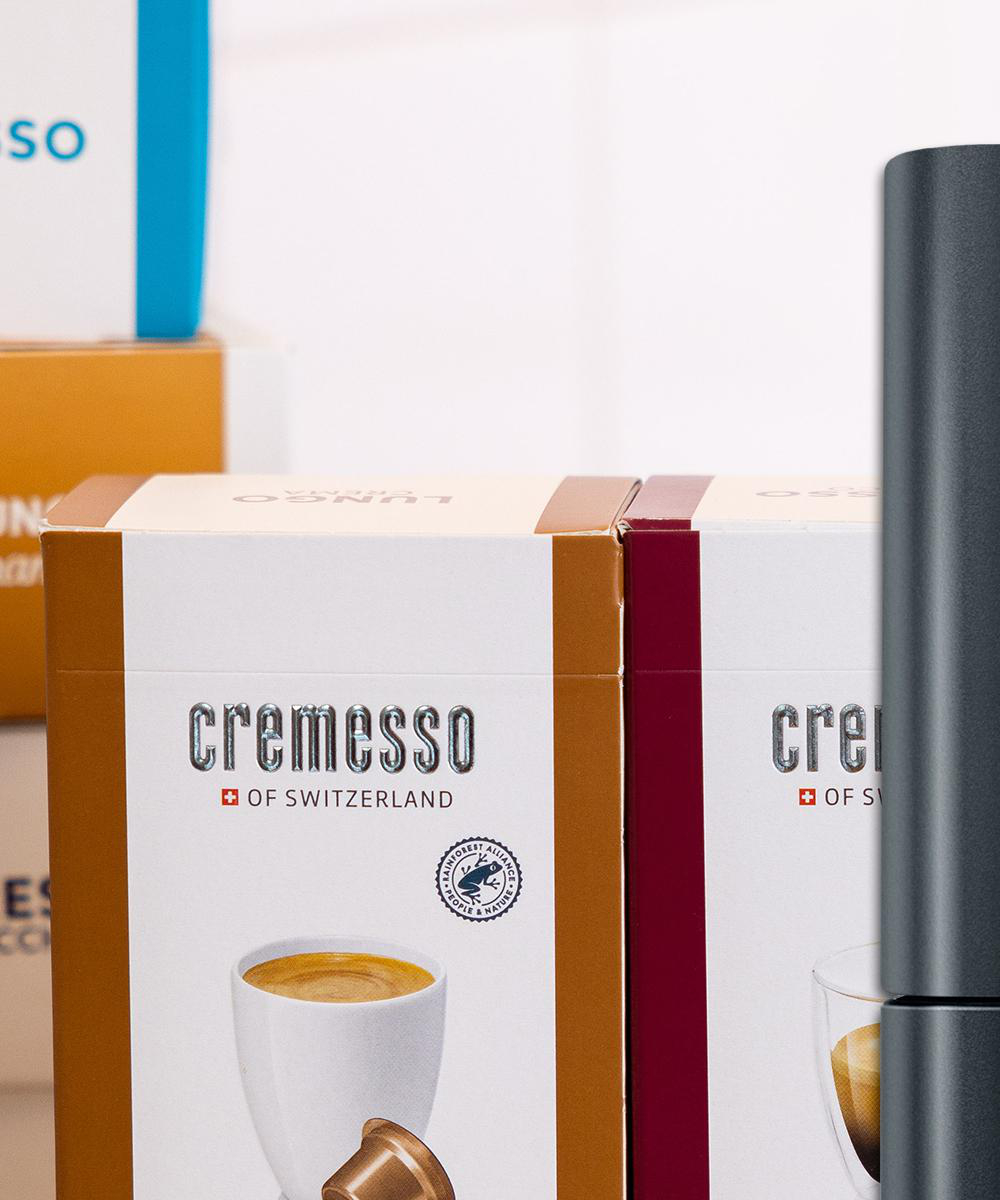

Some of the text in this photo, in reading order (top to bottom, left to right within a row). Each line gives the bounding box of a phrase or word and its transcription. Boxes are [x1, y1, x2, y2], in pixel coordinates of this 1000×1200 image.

[0, 120, 85, 160] SO
[232, 494, 453, 504] LUNGO
[189, 702, 476, 775] cremesso
[772, 703, 882, 774] cre
[248, 788, 454, 809] OF SWITZERLAND
[825, 787, 882, 806] OF S
[443, 843, 516, 882] RAINFOREST ALLIANCE
[445, 889, 474, 914] PEOPLE
[484, 889, 514, 914] NATURE
